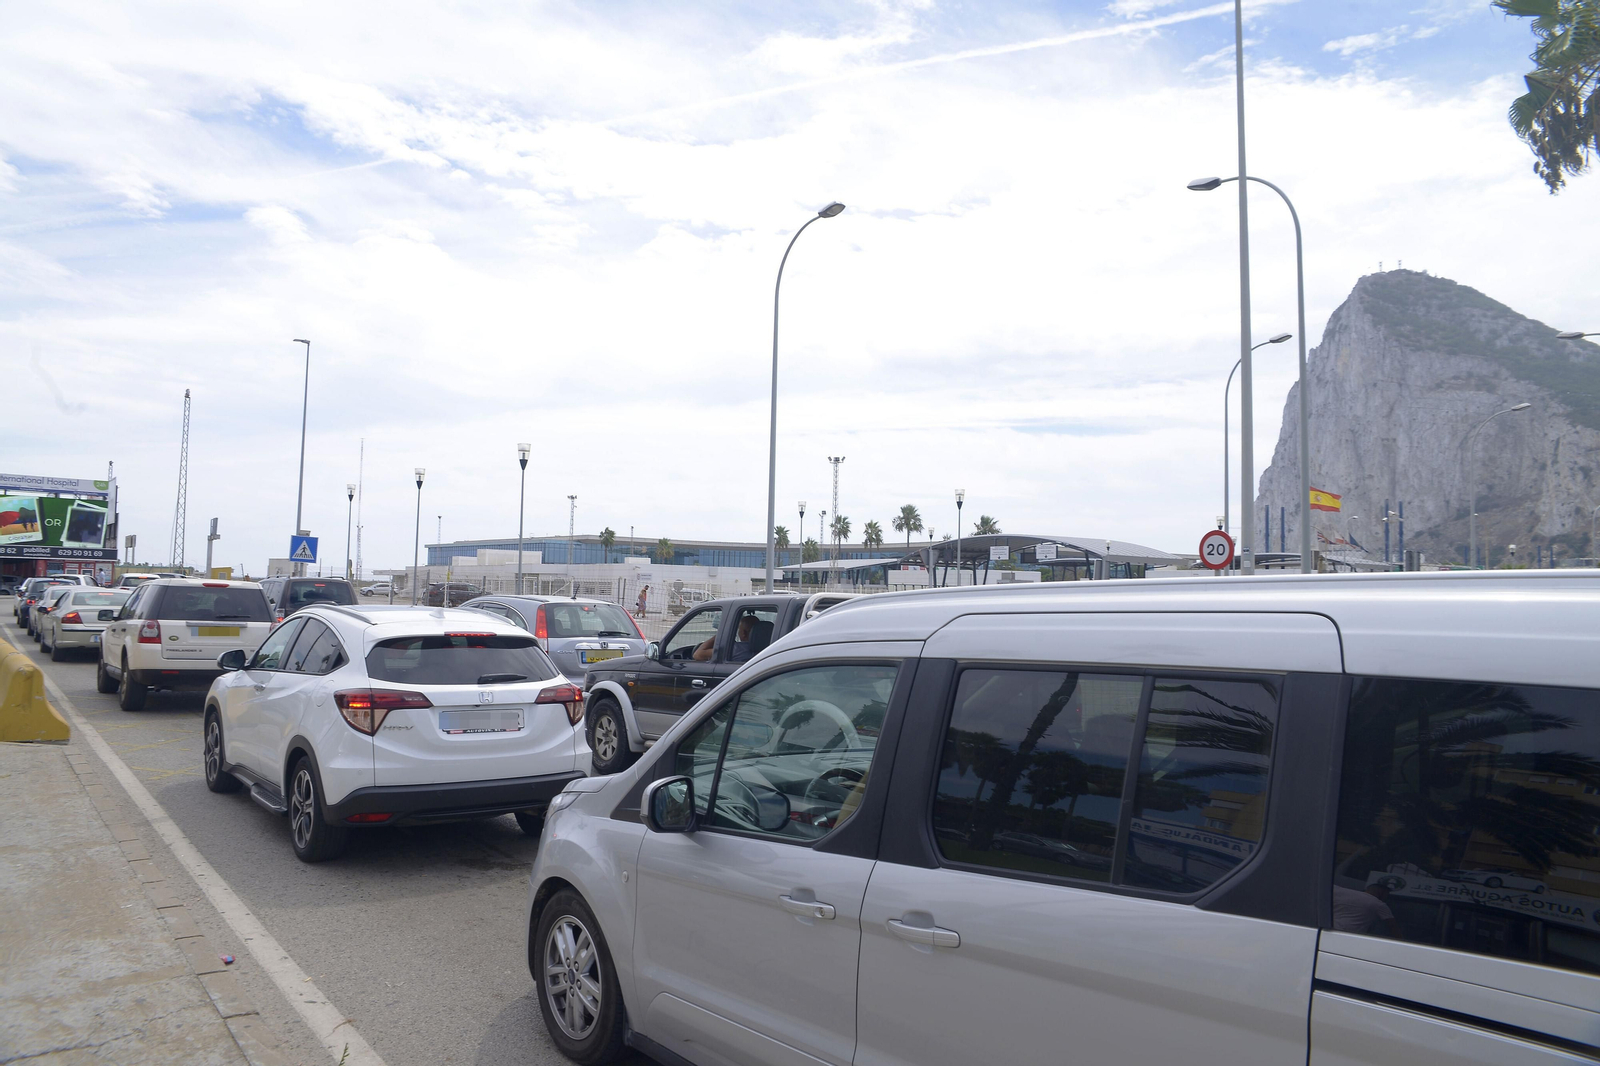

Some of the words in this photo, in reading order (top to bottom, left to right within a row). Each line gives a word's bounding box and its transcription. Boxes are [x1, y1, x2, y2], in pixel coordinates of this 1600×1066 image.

[47, 477, 79, 488] Hospital
[44, 518, 62, 527] OR
[1206, 543, 1226, 556] 20
